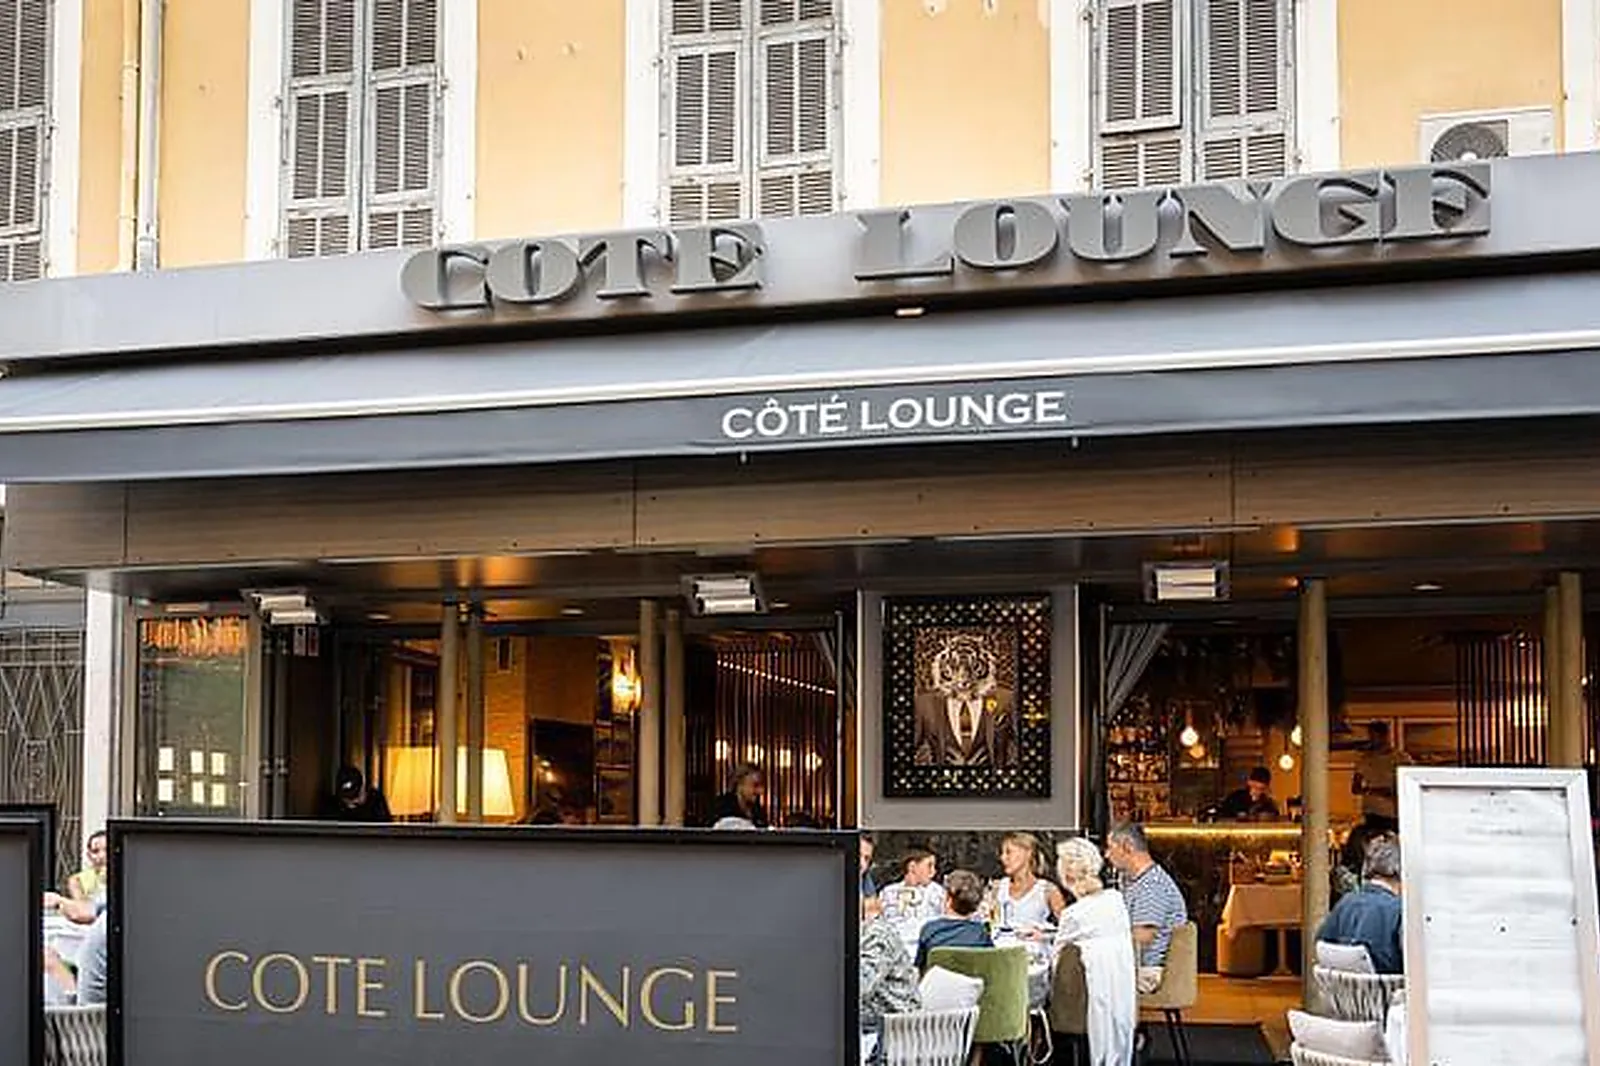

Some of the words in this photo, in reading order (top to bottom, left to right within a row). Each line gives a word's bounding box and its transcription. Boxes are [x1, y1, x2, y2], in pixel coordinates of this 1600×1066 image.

[400, 222, 763, 311] COTE
[854, 163, 1492, 281] LOUNGE
[722, 394, 847, 438] CÔTÉ
[861, 391, 1066, 430] LOUNGE
[205, 950, 388, 1018] COTE
[414, 959, 738, 1033] LOUNGE
